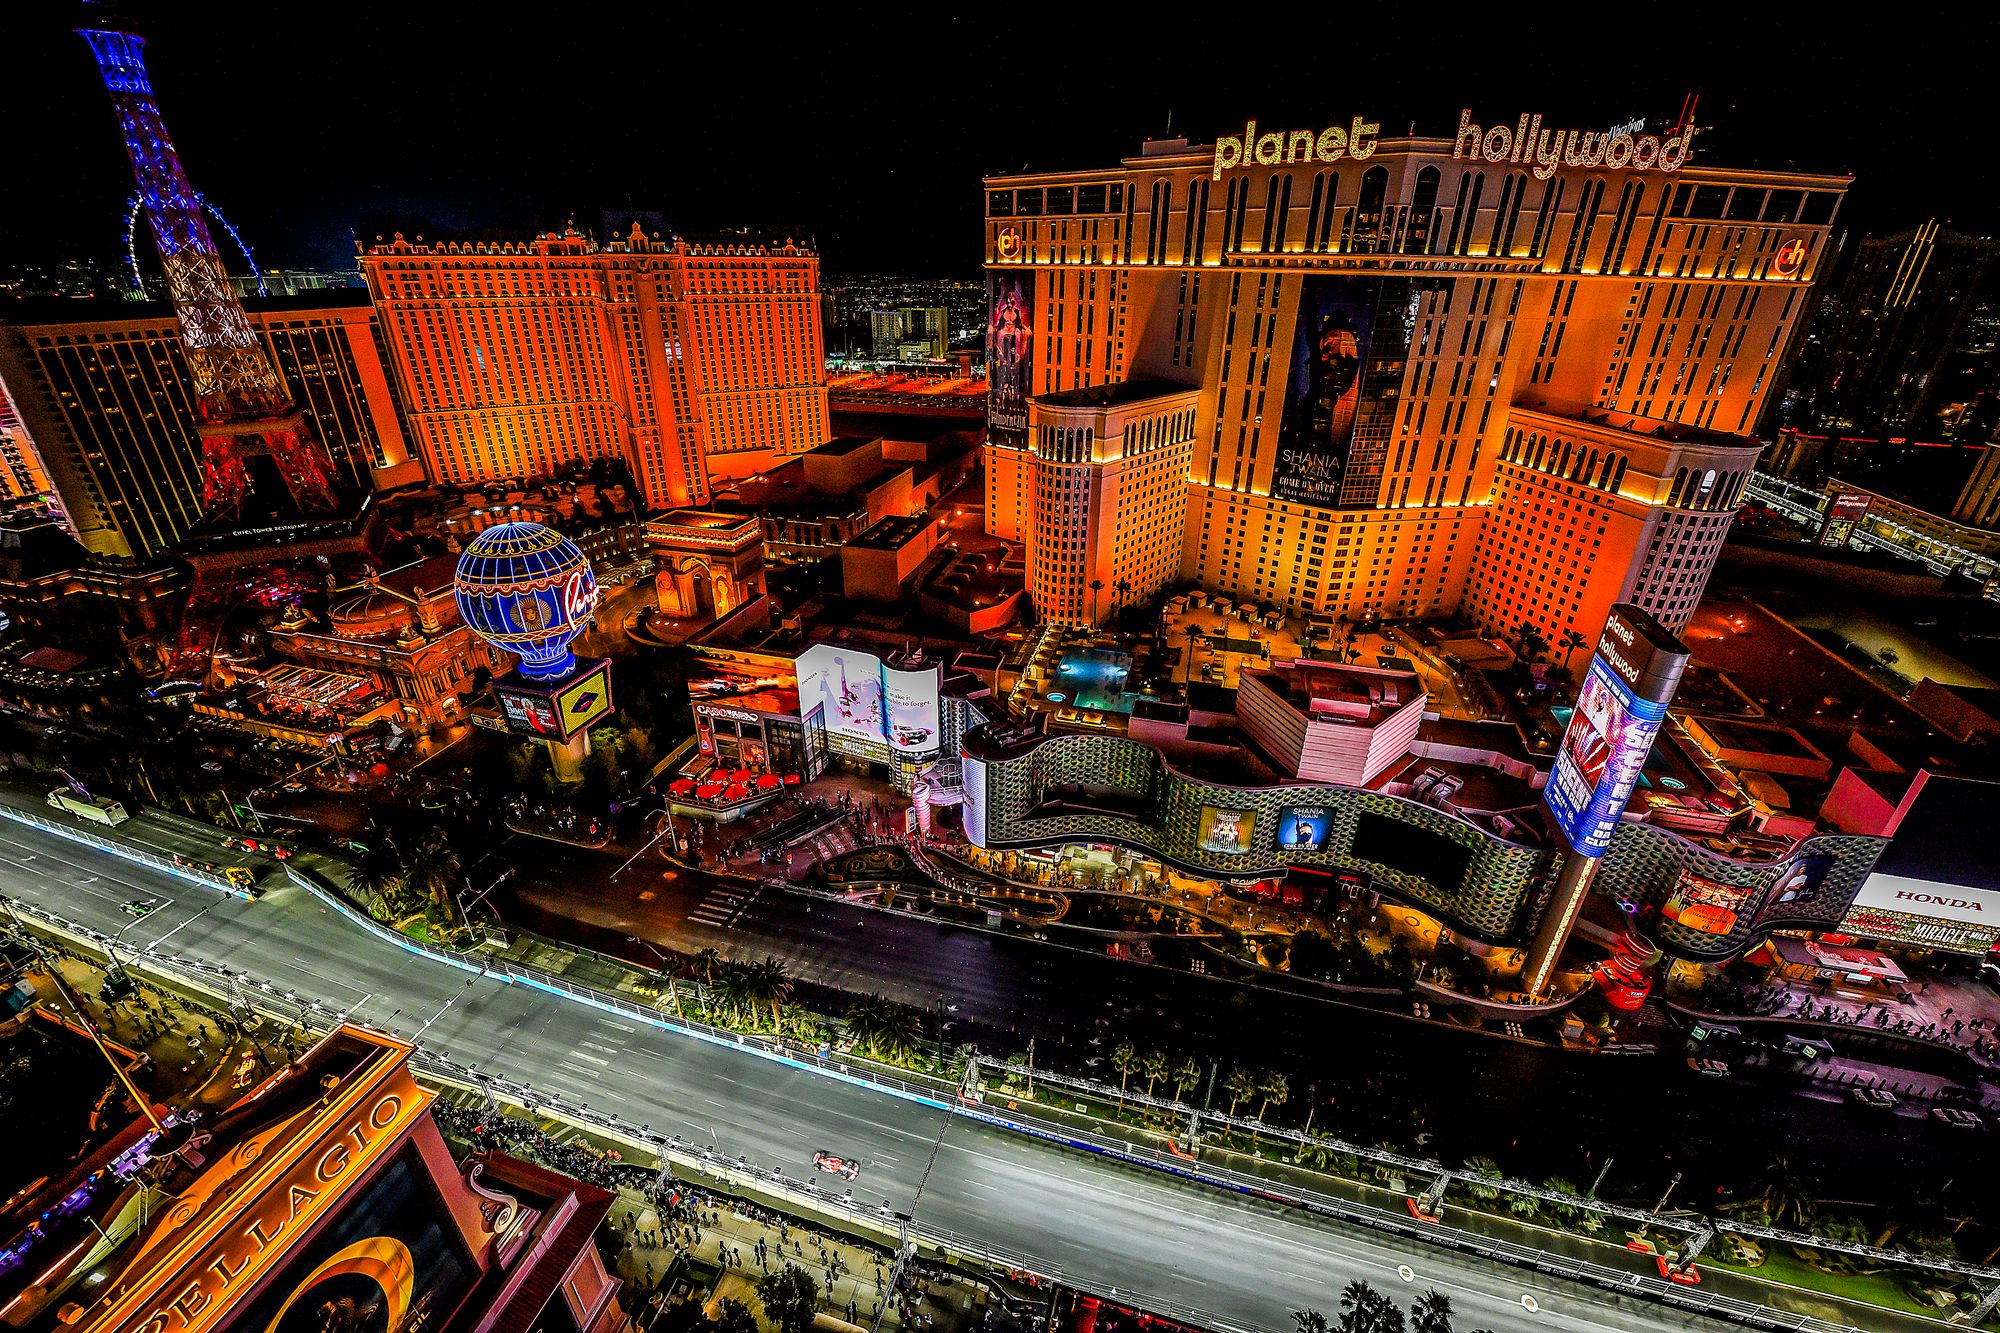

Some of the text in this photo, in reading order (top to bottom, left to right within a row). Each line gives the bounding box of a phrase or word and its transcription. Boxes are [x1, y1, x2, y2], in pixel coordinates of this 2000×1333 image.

[1212, 108, 1695, 182] planet hollywood
[1282, 449, 1340, 469] SHANIA
[1290, 462, 1332, 479] TWAIN
[1279, 475, 1300, 489] COME
[252, 526, 274, 534] TOWER
[565, 571, 600, 631] Paris
[1605, 615, 1635, 647] planet
[1599, 633, 1640, 683] hollywood
[841, 727, 871, 738] HONDA
[1293, 807, 1325, 815] SHANIA
[1895, 890, 1983, 911] HONDA
[1911, 923, 1989, 944] MIRACLE MILE
[946, 1106, 1071, 1144] AMERICAN EXPRESS
[1101, 1149, 1173, 1171] AMERICAN
